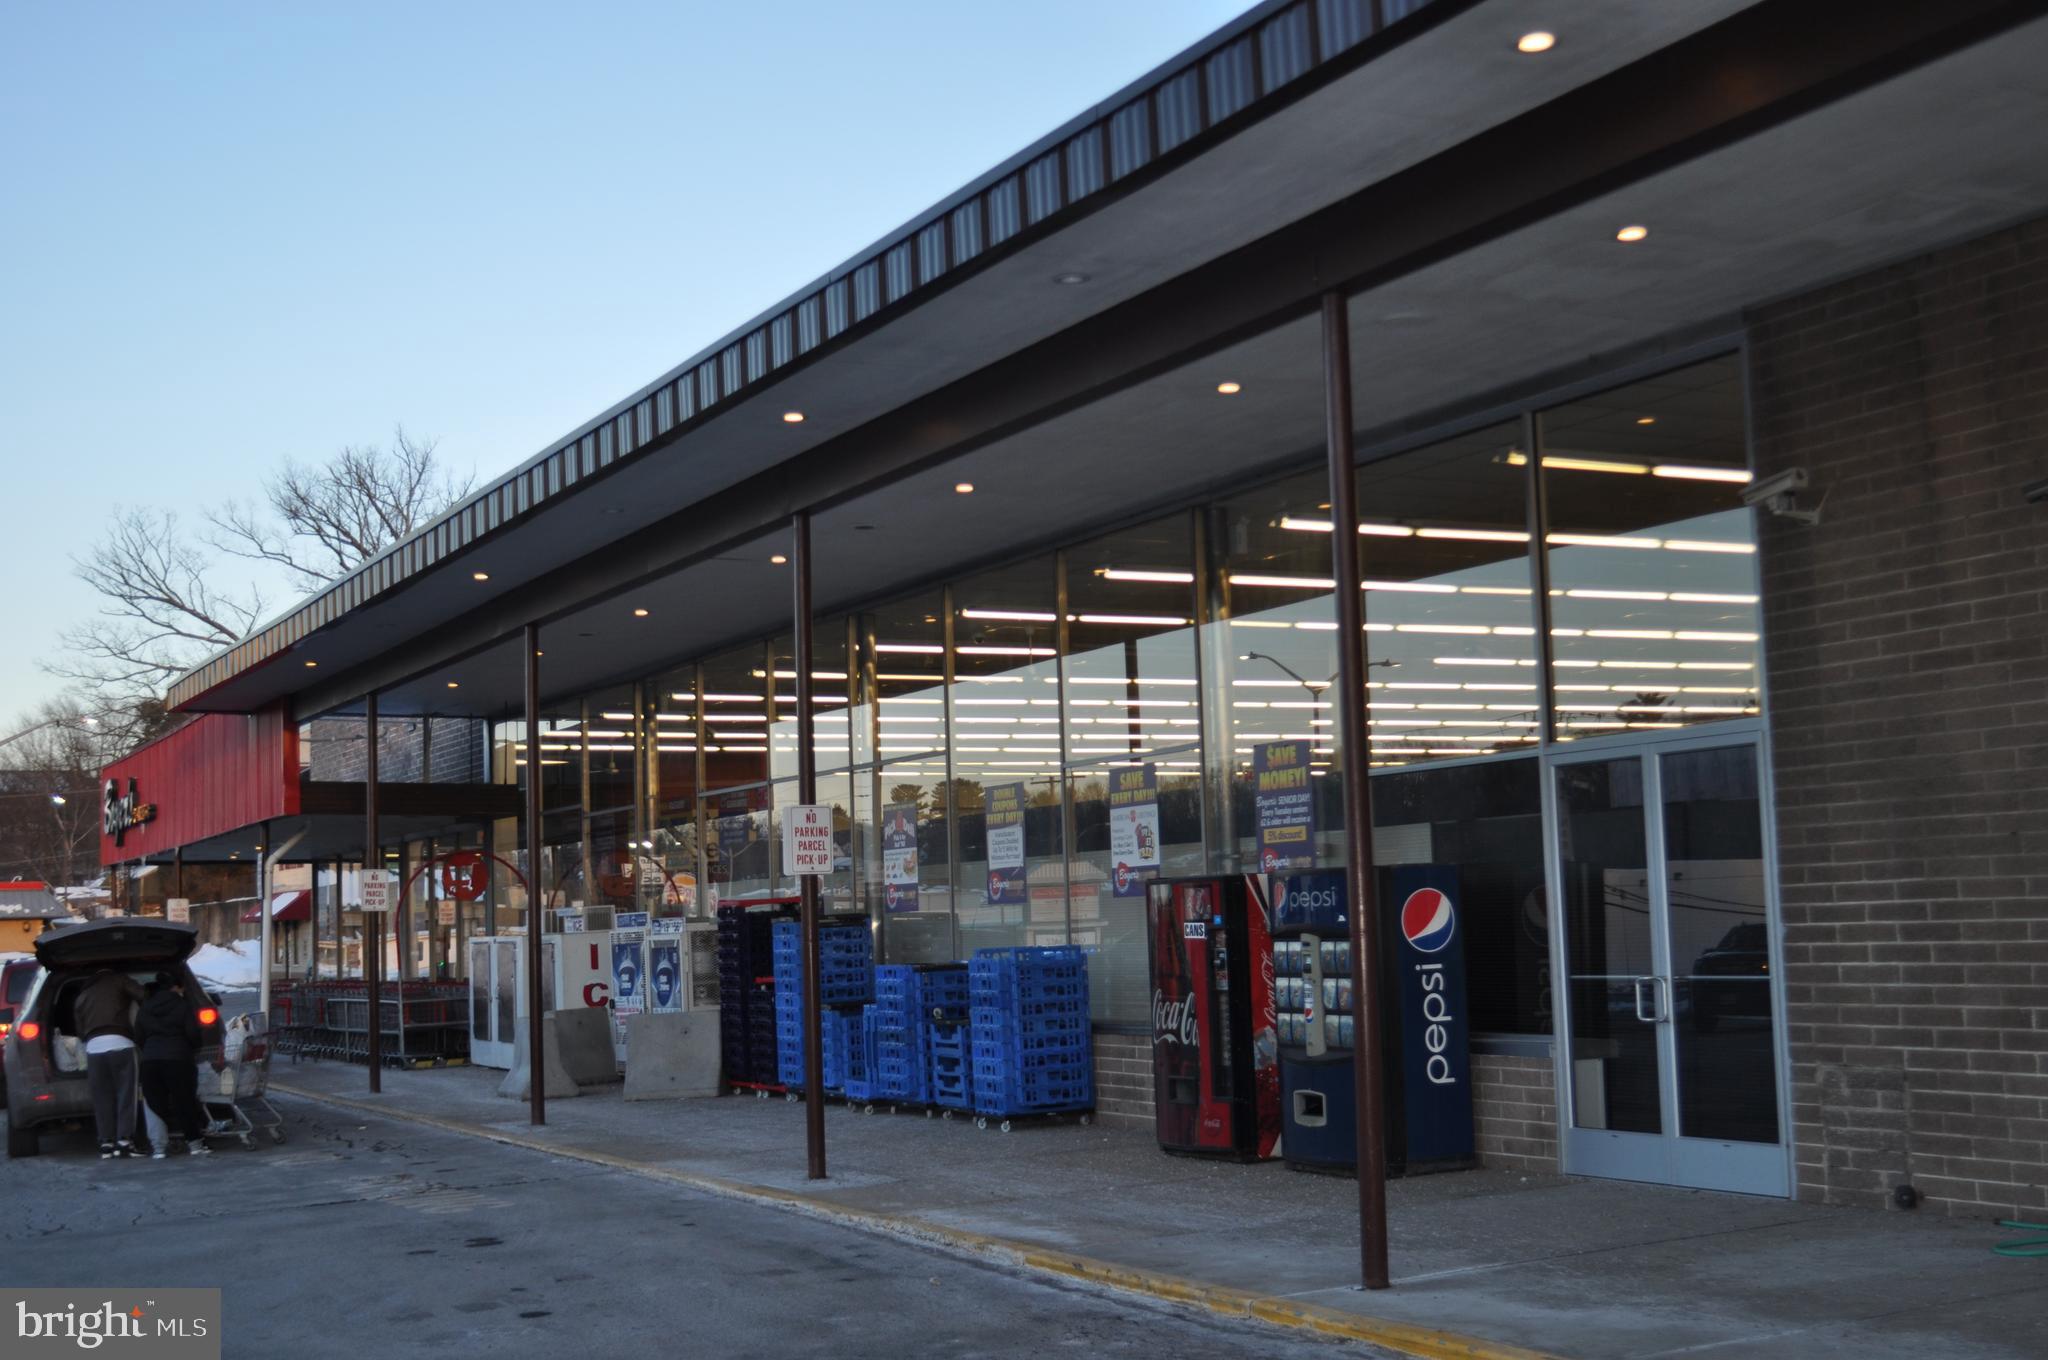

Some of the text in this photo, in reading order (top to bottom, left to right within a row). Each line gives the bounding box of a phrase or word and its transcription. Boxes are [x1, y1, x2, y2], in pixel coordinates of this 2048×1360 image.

[1120, 770, 1144, 790] SAVE
[1258, 766, 1307, 791] MONEY!
[1111, 792, 1131, 805] EVERY
[1278, 794, 1296, 806] SENIOR
[805, 812, 817, 824] NO
[794, 826, 829, 838] PARKING
[798, 840, 827, 851] PARCEL
[1289, 885, 1337, 912] pepsi
[1184, 924, 1204, 937] CANS
[1415, 962, 1456, 1085] pepsi
